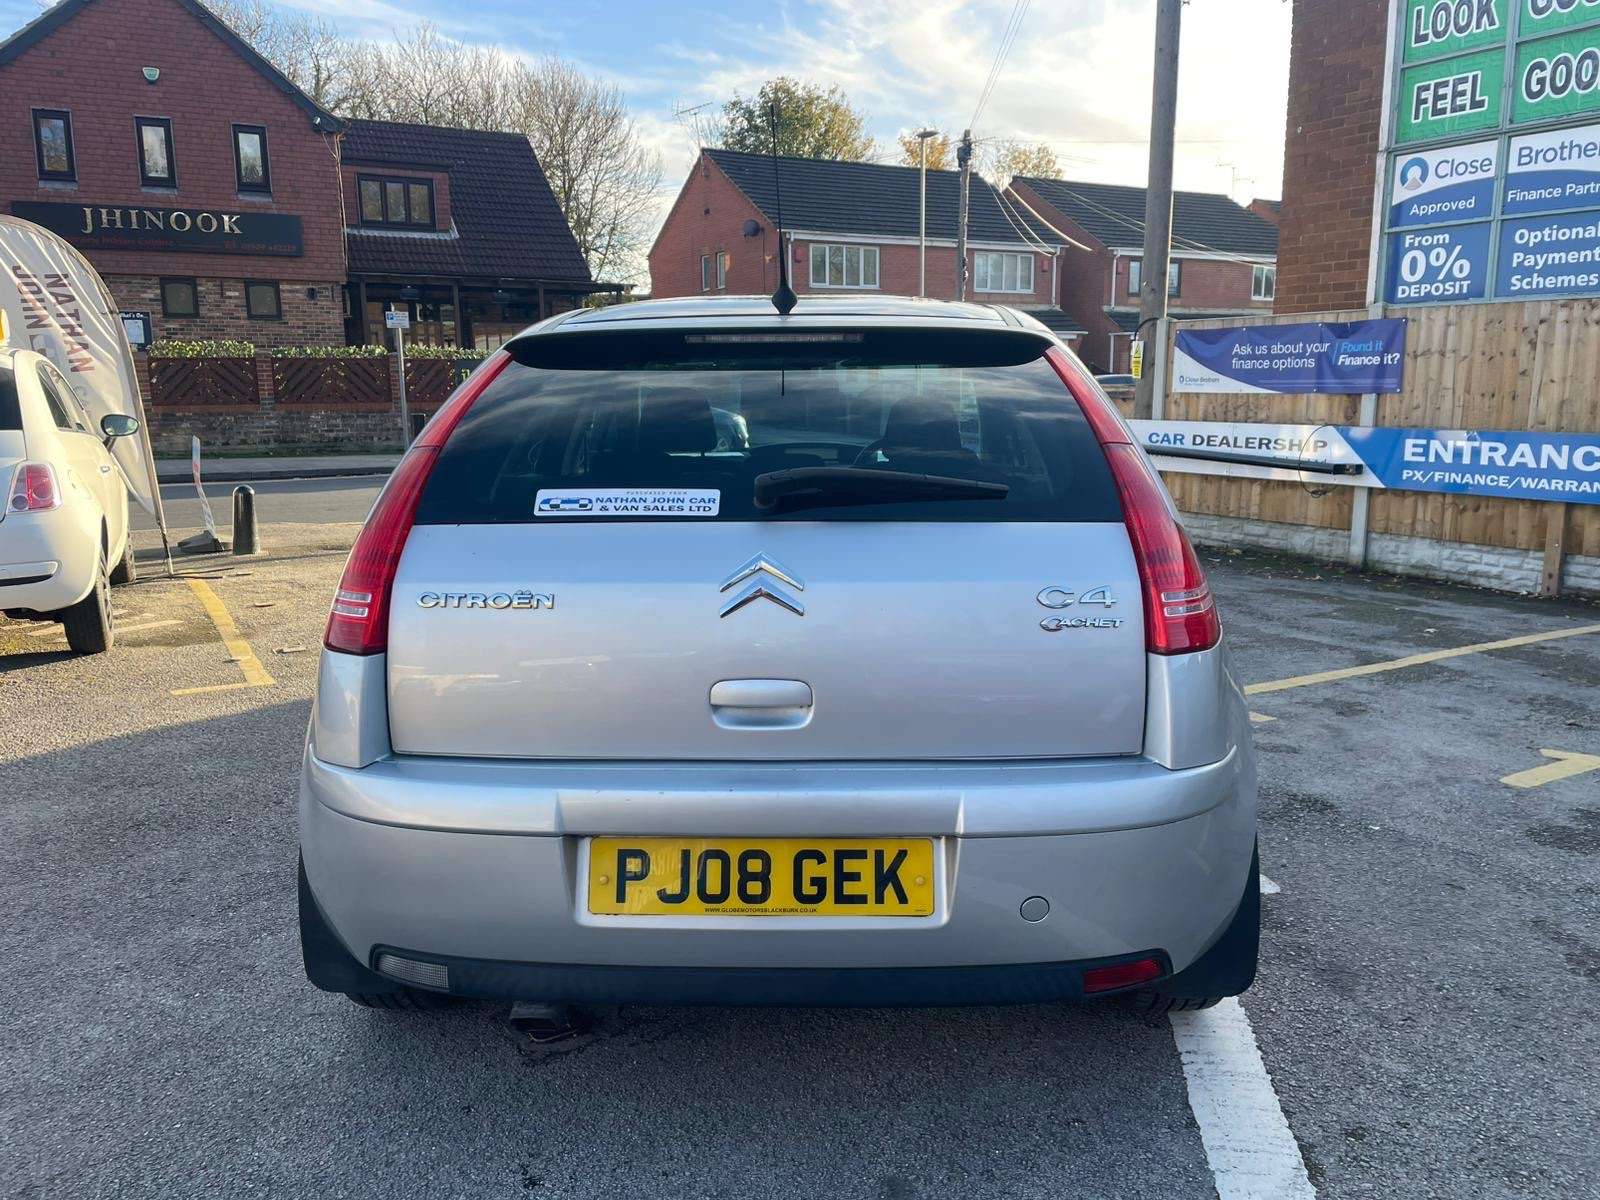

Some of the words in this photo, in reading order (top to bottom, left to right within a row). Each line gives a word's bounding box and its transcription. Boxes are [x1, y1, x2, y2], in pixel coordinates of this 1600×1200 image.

[1411, 0, 1498, 47] LOOK
[1411, 71, 1488, 123] FEEL
[1522, 47, 1600, 103] GOO
[1434, 156, 1493, 180] Close
[1409, 196, 1475, 216] Approved
[1507, 186, 1562, 202] Finance
[81, 207, 243, 234] JHINOOK
[1404, 232, 1450, 248] From
[1514, 220, 1600, 247] Optional
[1401, 244, 1471, 283] 0%
[1511, 246, 1600, 270] Payment
[1397, 280, 1471, 299] DEPOSIT
[1510, 273, 1599, 291] Schemes
[12, 265, 53, 330] JOHN
[44, 273, 95, 373] NATHAN
[1232, 343, 1252, 356] Ask
[1255, 345, 1268, 355] us
[1270, 341, 1304, 354] about
[1306, 343, 1331, 357] your
[1340, 341, 1373, 353] Found
[1374, 340, 1384, 352] it
[1232, 357, 1270, 370] finance
[1272, 356, 1316, 372] options
[1338, 354, 1381, 366] Finance
[1383, 352, 1400, 365] it?
[1148, 432, 1186, 446] CAR
[1191, 433, 1329, 454] DEALERSHIP
[1403, 438, 1600, 472] ENTRANC
[595, 496, 648, 504] NATHAN
[650, 496, 685, 504] JOHN
[416, 589, 556, 609] CITROËN
[1036, 585, 1118, 609] C4
[615, 848, 772, 905] PJ08
[792, 848, 910, 905] GEK
